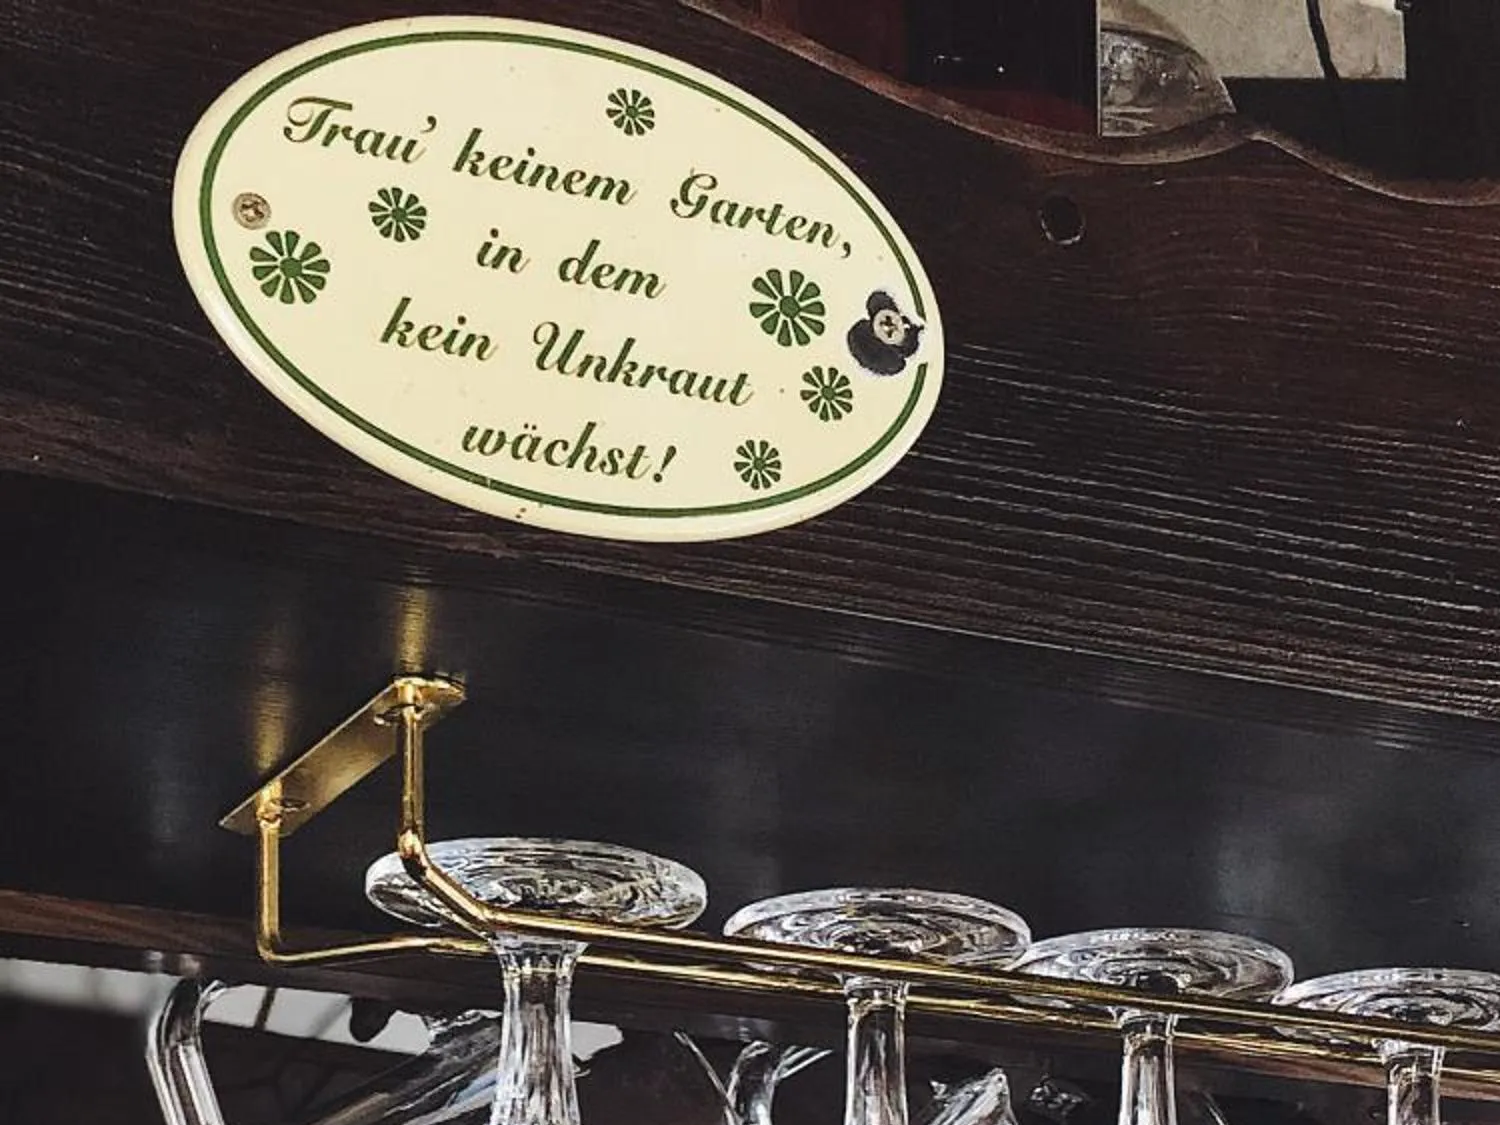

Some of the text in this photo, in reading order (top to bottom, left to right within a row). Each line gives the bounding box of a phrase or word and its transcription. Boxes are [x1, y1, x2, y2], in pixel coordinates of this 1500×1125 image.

[282, 95, 852, 259] Trau' keinem Garten,
[476, 228, 667, 300] in dem
[379, 295, 754, 407] kein Unkraut
[461, 420, 677, 484] wächst!
